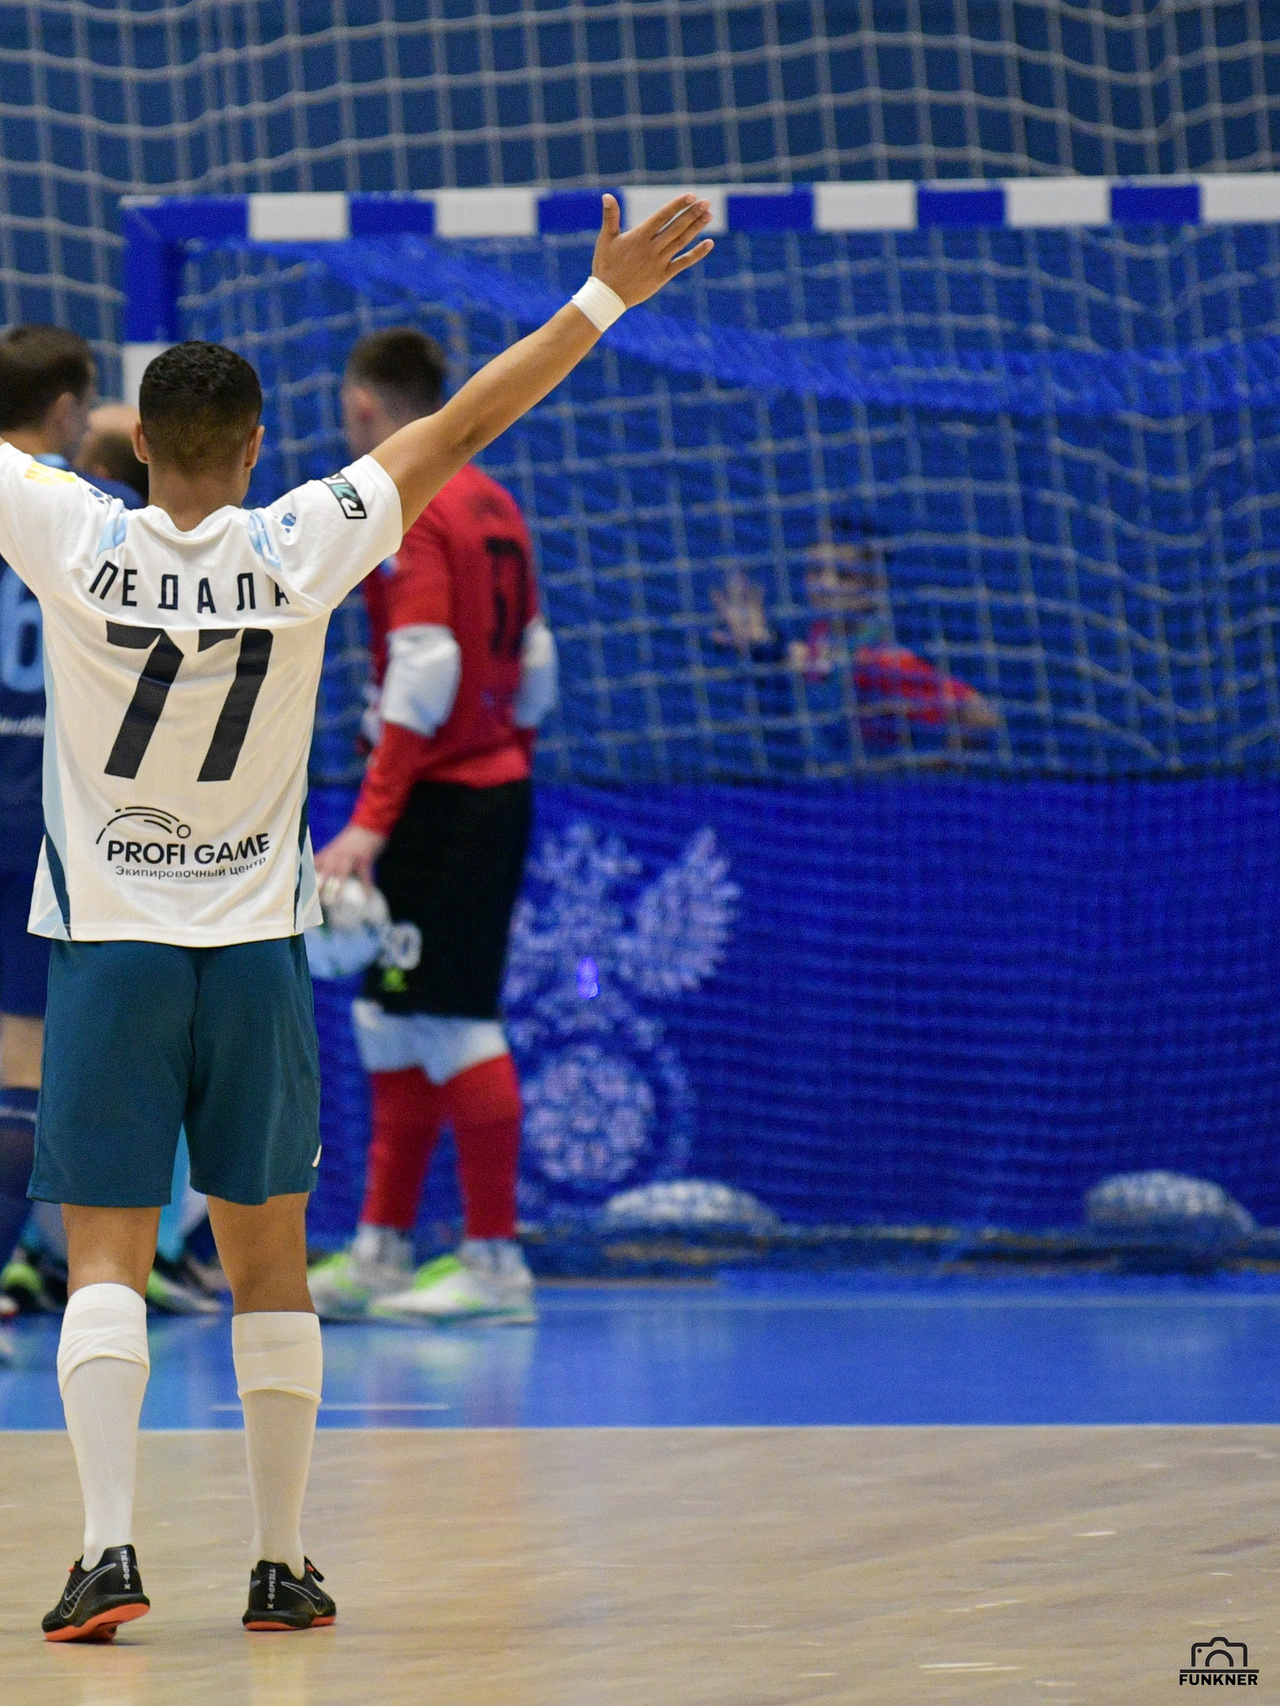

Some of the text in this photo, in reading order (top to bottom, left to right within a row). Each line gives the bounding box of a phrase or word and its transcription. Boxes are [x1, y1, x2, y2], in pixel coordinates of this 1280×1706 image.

[104, 620, 274, 782] 77
[107, 832, 270, 865] PROFI GAME
[115, 856, 267, 880] Экипировочный центр
